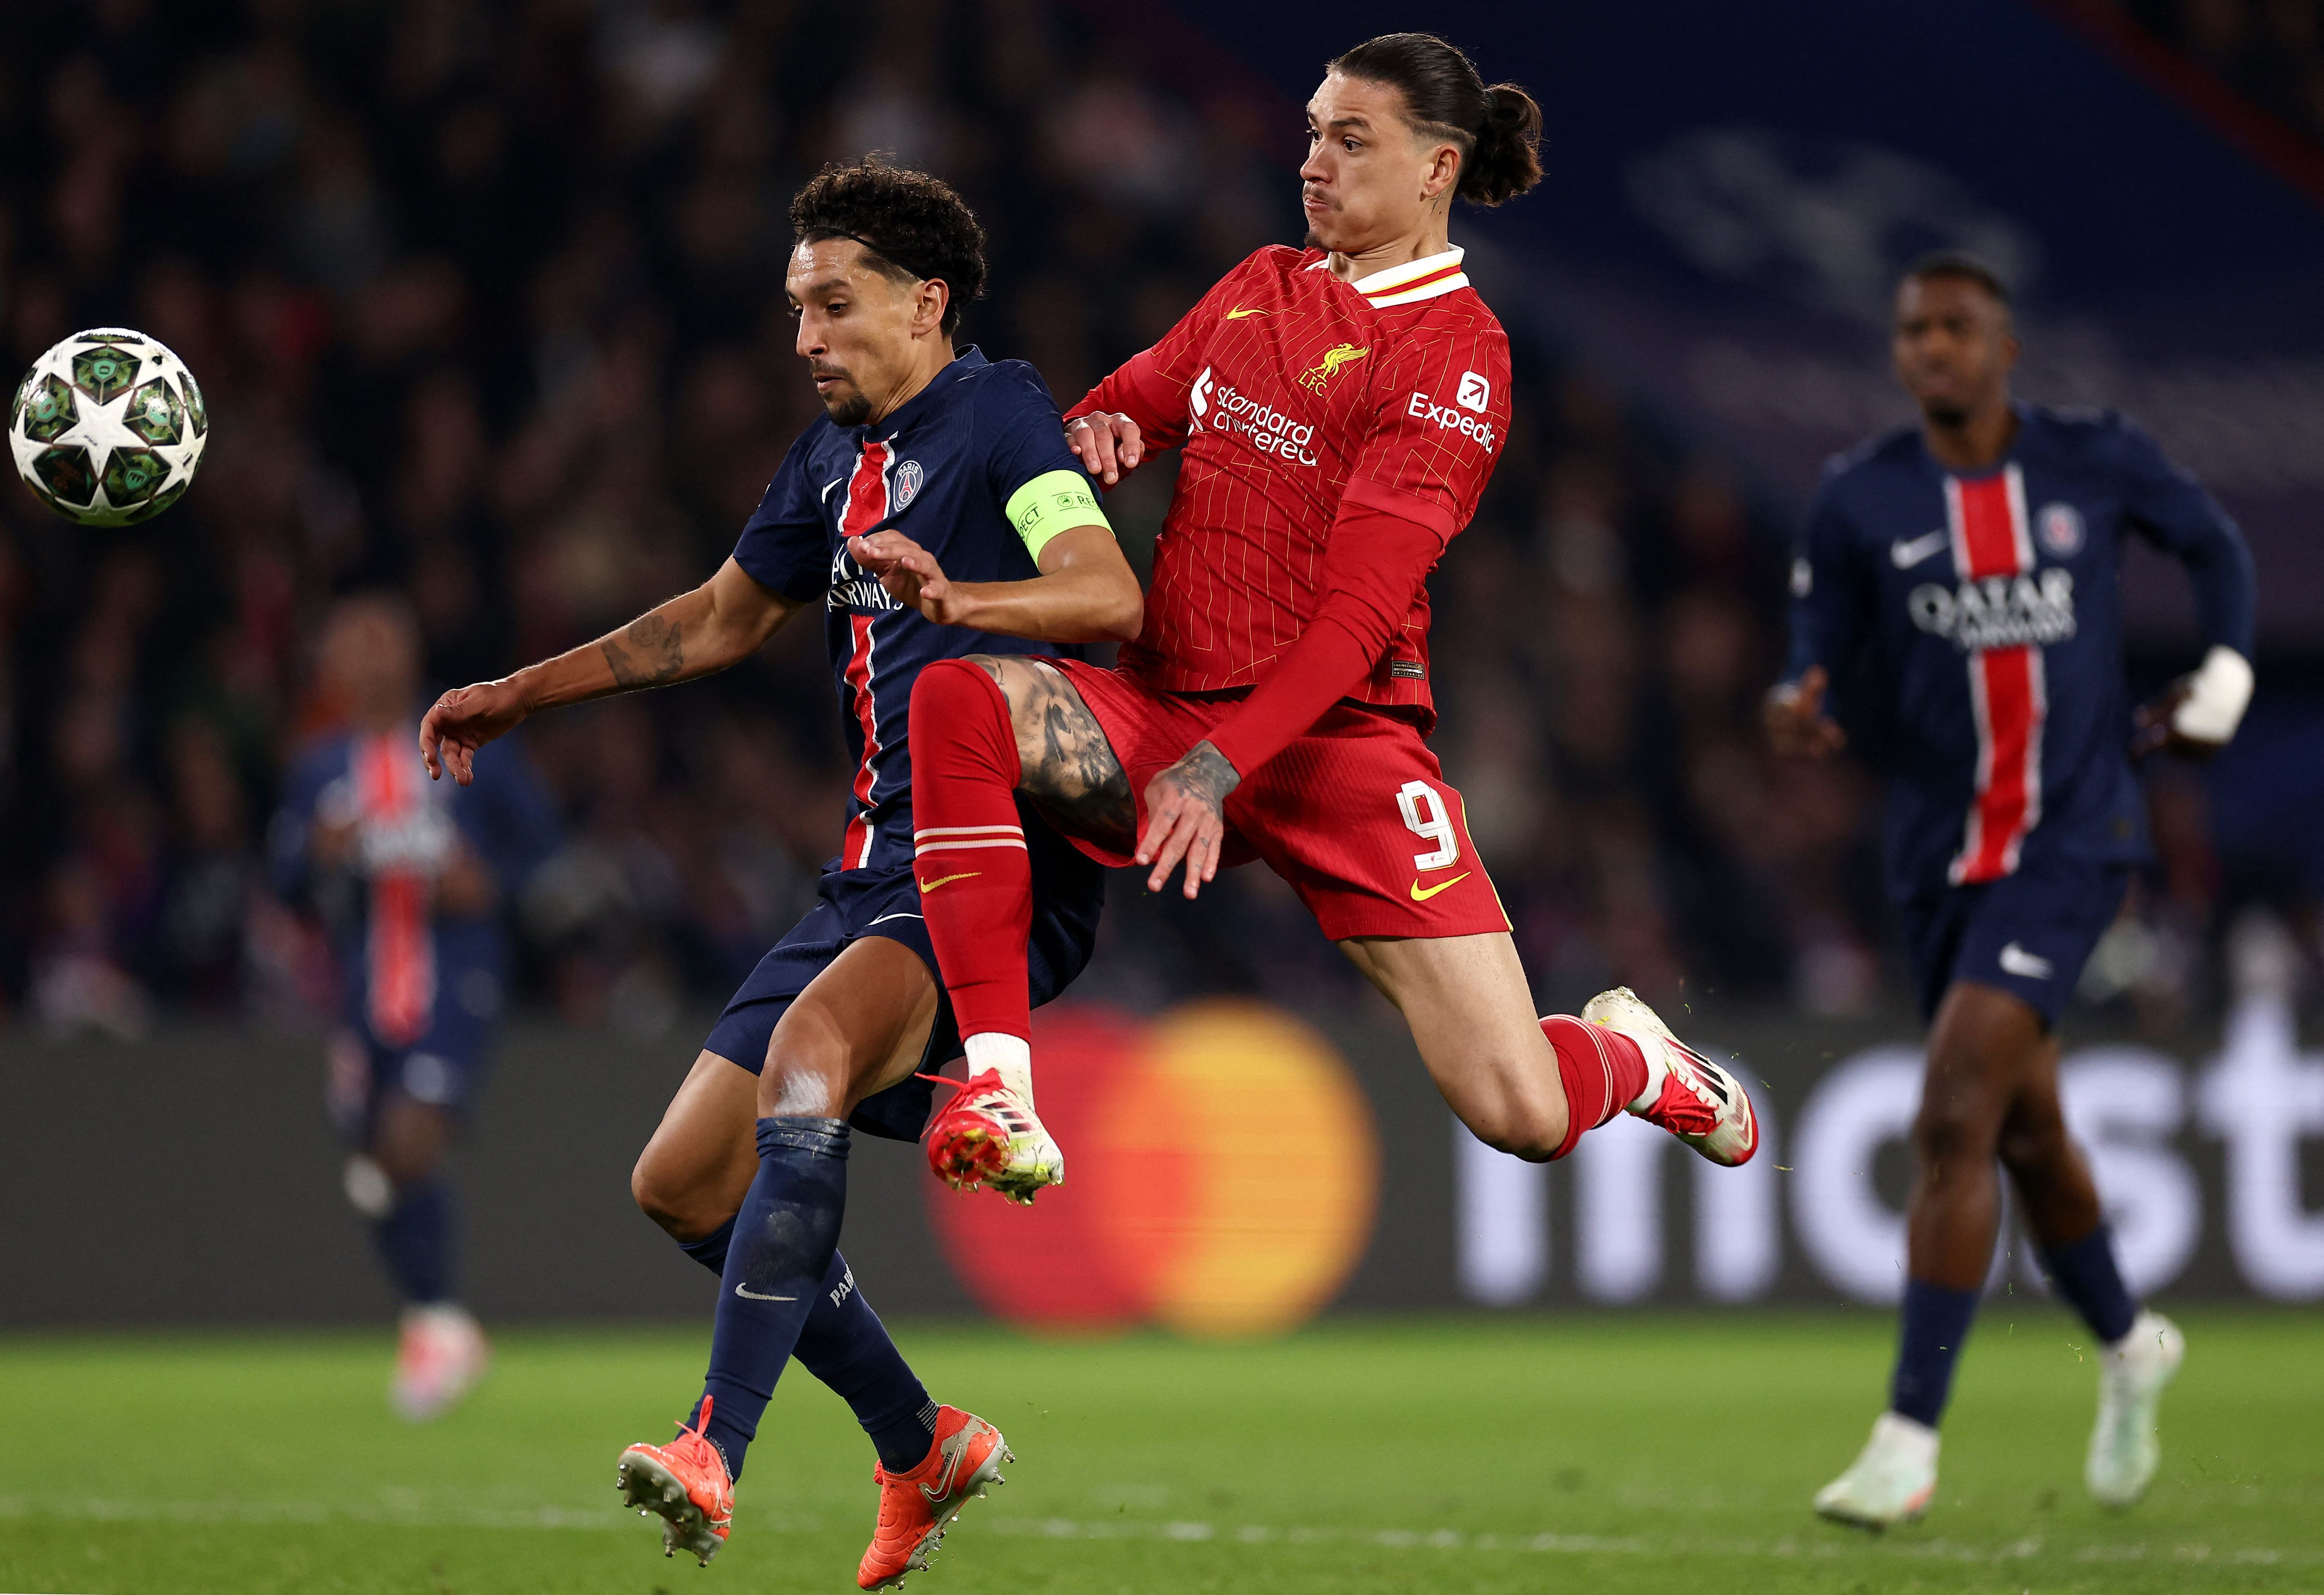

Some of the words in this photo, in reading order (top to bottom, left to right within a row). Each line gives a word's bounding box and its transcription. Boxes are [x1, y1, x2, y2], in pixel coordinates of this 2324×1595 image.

[1217, 386, 1314, 446] standard
[898, 463, 919, 478] PARIS
[827, 581, 904, 613] AIRWAY
[1395, 779, 1460, 872] 9
